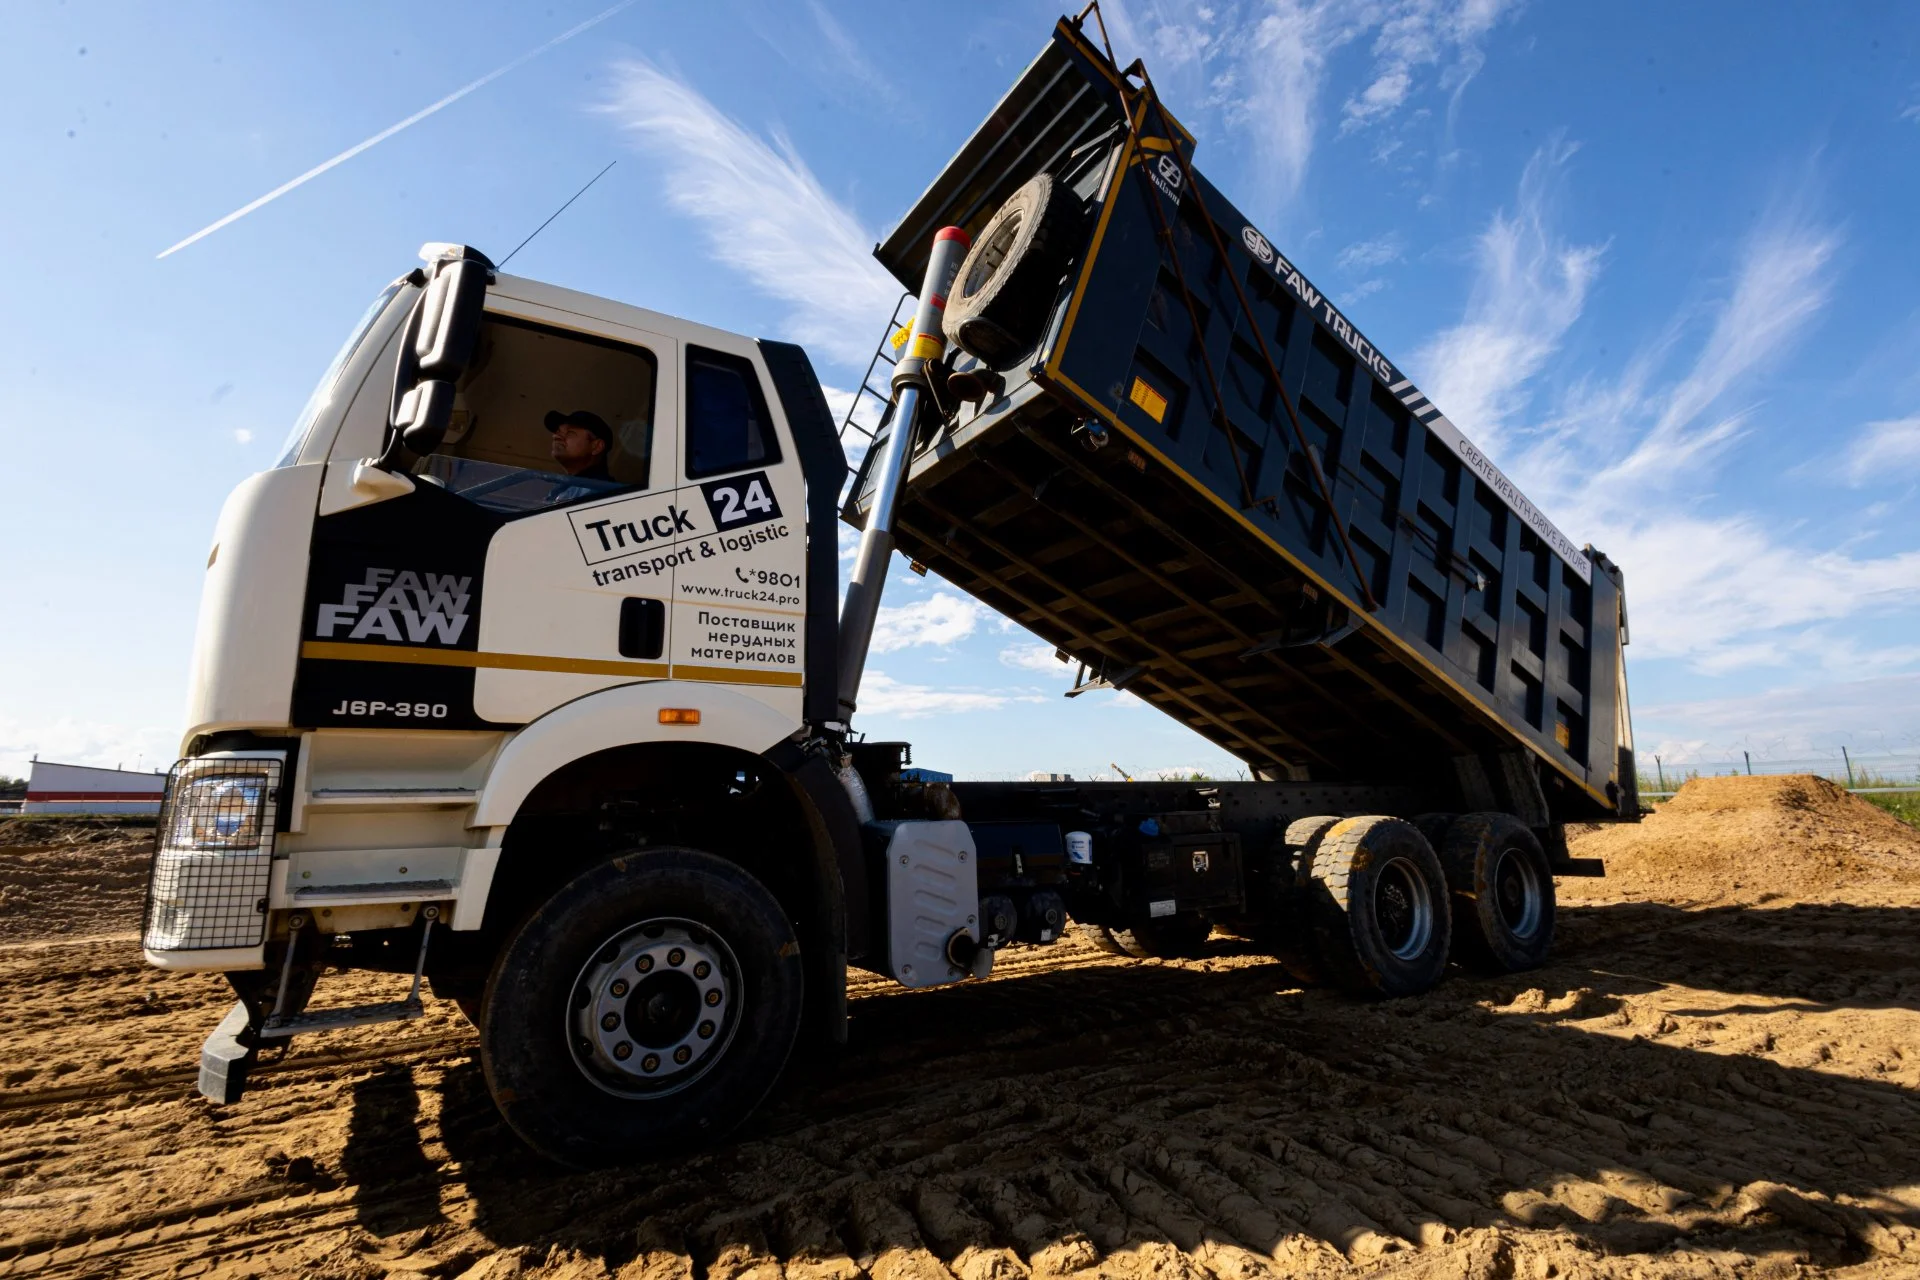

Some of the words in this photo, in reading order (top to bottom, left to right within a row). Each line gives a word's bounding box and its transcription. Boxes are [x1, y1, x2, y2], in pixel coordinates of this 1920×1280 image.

[1274, 256, 1321, 309] FAW
[1323, 302, 1392, 383] TRUCKS
[585, 505, 696, 552] Truck
[712, 480, 773, 523] 24
[1459, 440, 1497, 480] CREATE
[1558, 538, 1588, 575] FUTURE
[592, 546, 696, 587] transport
[700, 541, 716, 558] &
[718, 524, 789, 553] logistic
[342, 583, 471, 619] FAW
[681, 584, 800, 605] www.truck24.pro
[316, 603, 470, 645] FAW
[698, 611, 796, 633] Поставщик
[708, 631, 796, 648] нерудных
[691, 647, 796, 664] материалов
[332, 700, 448, 718] J6P-390
